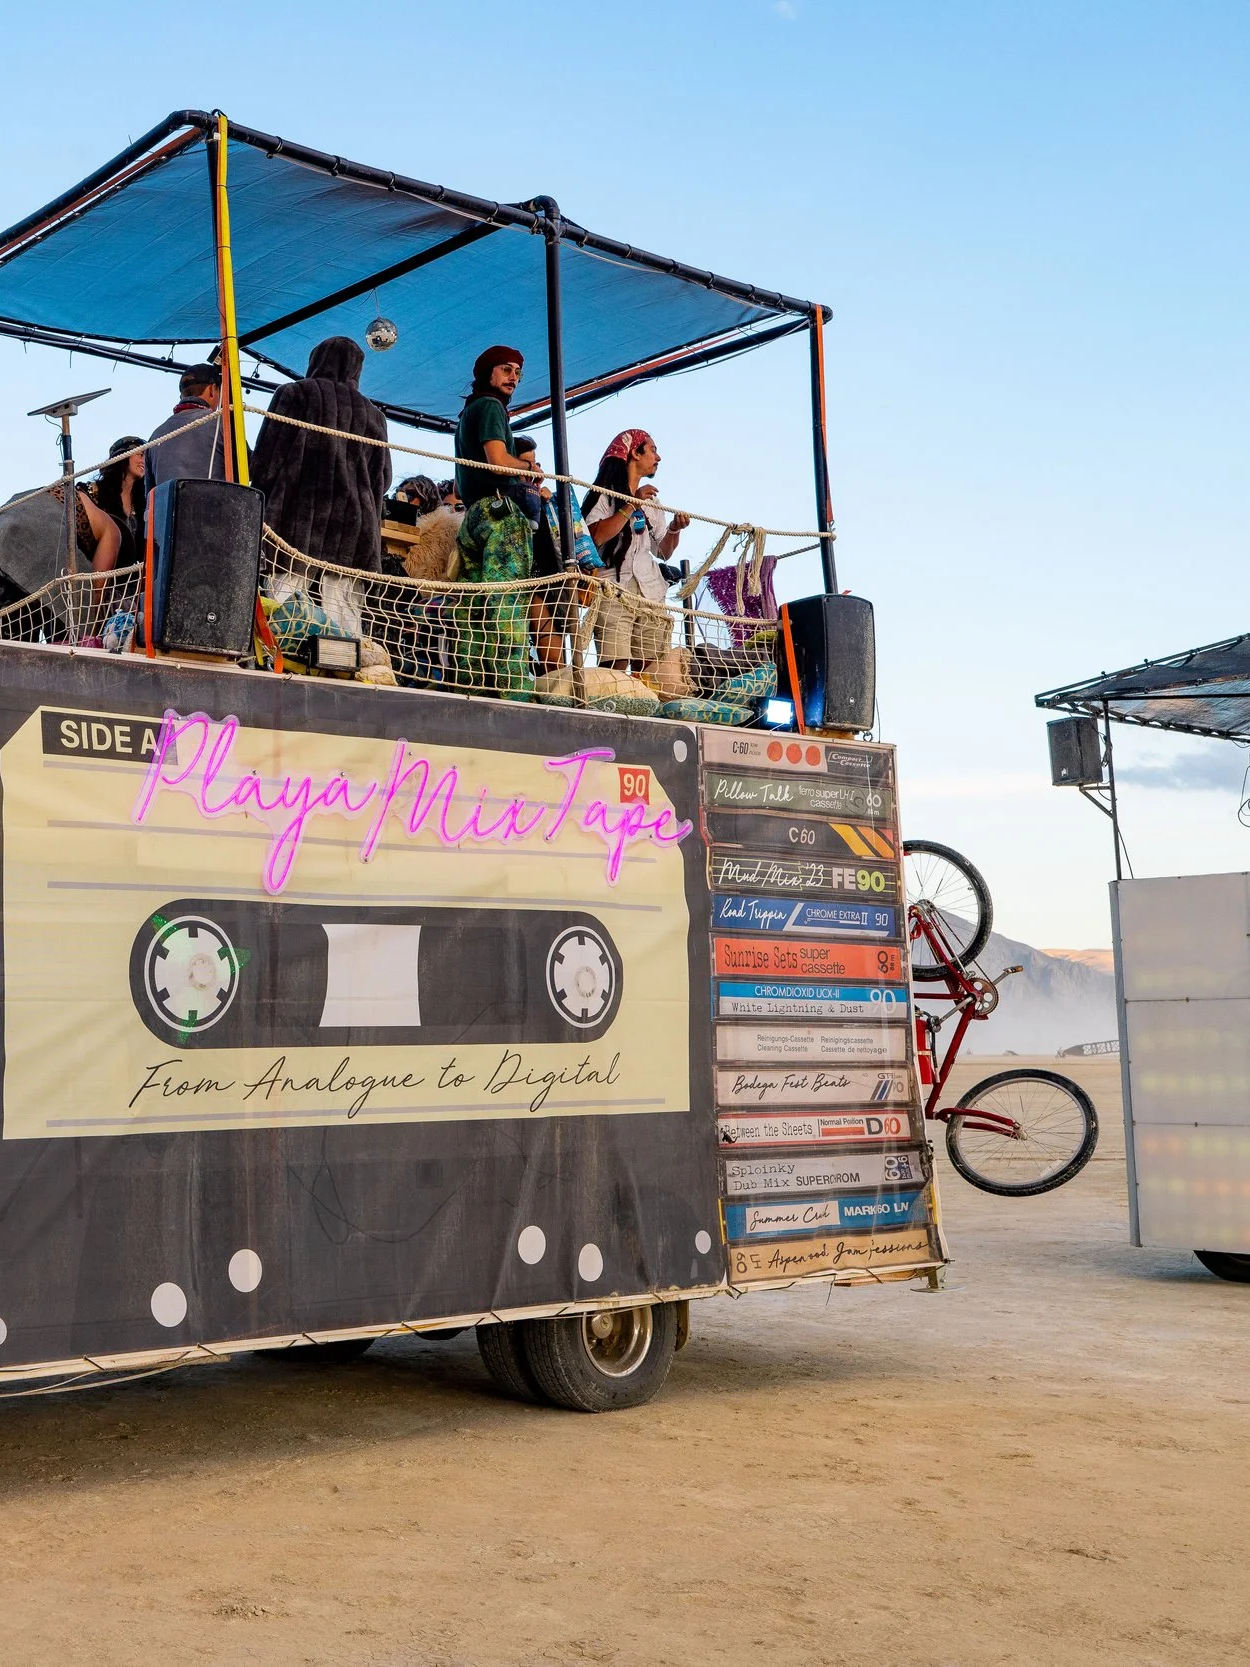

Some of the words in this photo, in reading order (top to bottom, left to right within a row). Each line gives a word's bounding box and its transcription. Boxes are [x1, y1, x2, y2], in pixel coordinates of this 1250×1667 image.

[60, 719, 133, 754] SIDE
[140, 728, 161, 756] A
[732, 741, 749, 755] C-60
[622, 775, 645, 798] 90
[714, 778, 758, 800] Pillow
[759, 784, 794, 803] Talk
[815, 789, 839, 800] super
[136, 714, 379, 891] Playa
[718, 857, 761, 885] Mud
[761, 860, 803, 887] Mix
[832, 866, 886, 893] FE90
[719, 898, 747, 919] Road
[747, 900, 788, 930] Trippin
[805, 908, 838, 920] CHROME
[838, 911, 861, 921] EXTRA
[875, 913, 889, 927] 90
[724, 943, 770, 969] Sunrise
[773, 945, 798, 969] Sets
[799, 947, 831, 960] super
[800, 961, 846, 975] cassette
[754, 985, 815, 998] CHROMDIOXID
[816, 988, 840, 999] UCX-II
[869, 988, 897, 1014] 90
[731, 1002, 763, 1013] White
[767, 1003, 823, 1015] Lightning
[827, 1004, 835, 1013] &
[840, 1003, 865, 1014] Dust
[757, 1044, 783, 1053] Cleaning
[783, 1044, 809, 1053] Cassette
[820, 1045, 846, 1053] Cassette
[847, 1045, 856, 1053] de
[130, 1058, 237, 1108] From
[243, 1055, 426, 1119] Analogue
[437, 1057, 476, 1089] to
[484, 1052, 621, 1113] Digital
[731, 1074, 778, 1100] Bodega
[780, 1073, 809, 1092] Fest
[810, 1072, 852, 1092] Beats
[763, 1123, 779, 1137] the
[781, 1121, 813, 1137] Sheets
[820, 1118, 842, 1126] Normal
[731, 1163, 796, 1178] Sploinky
[733, 1180, 758, 1191] Dub
[763, 1178, 791, 1189] Mix
[750, 1211, 799, 1231] Summer
[832, 1241, 869, 1265] Jam
